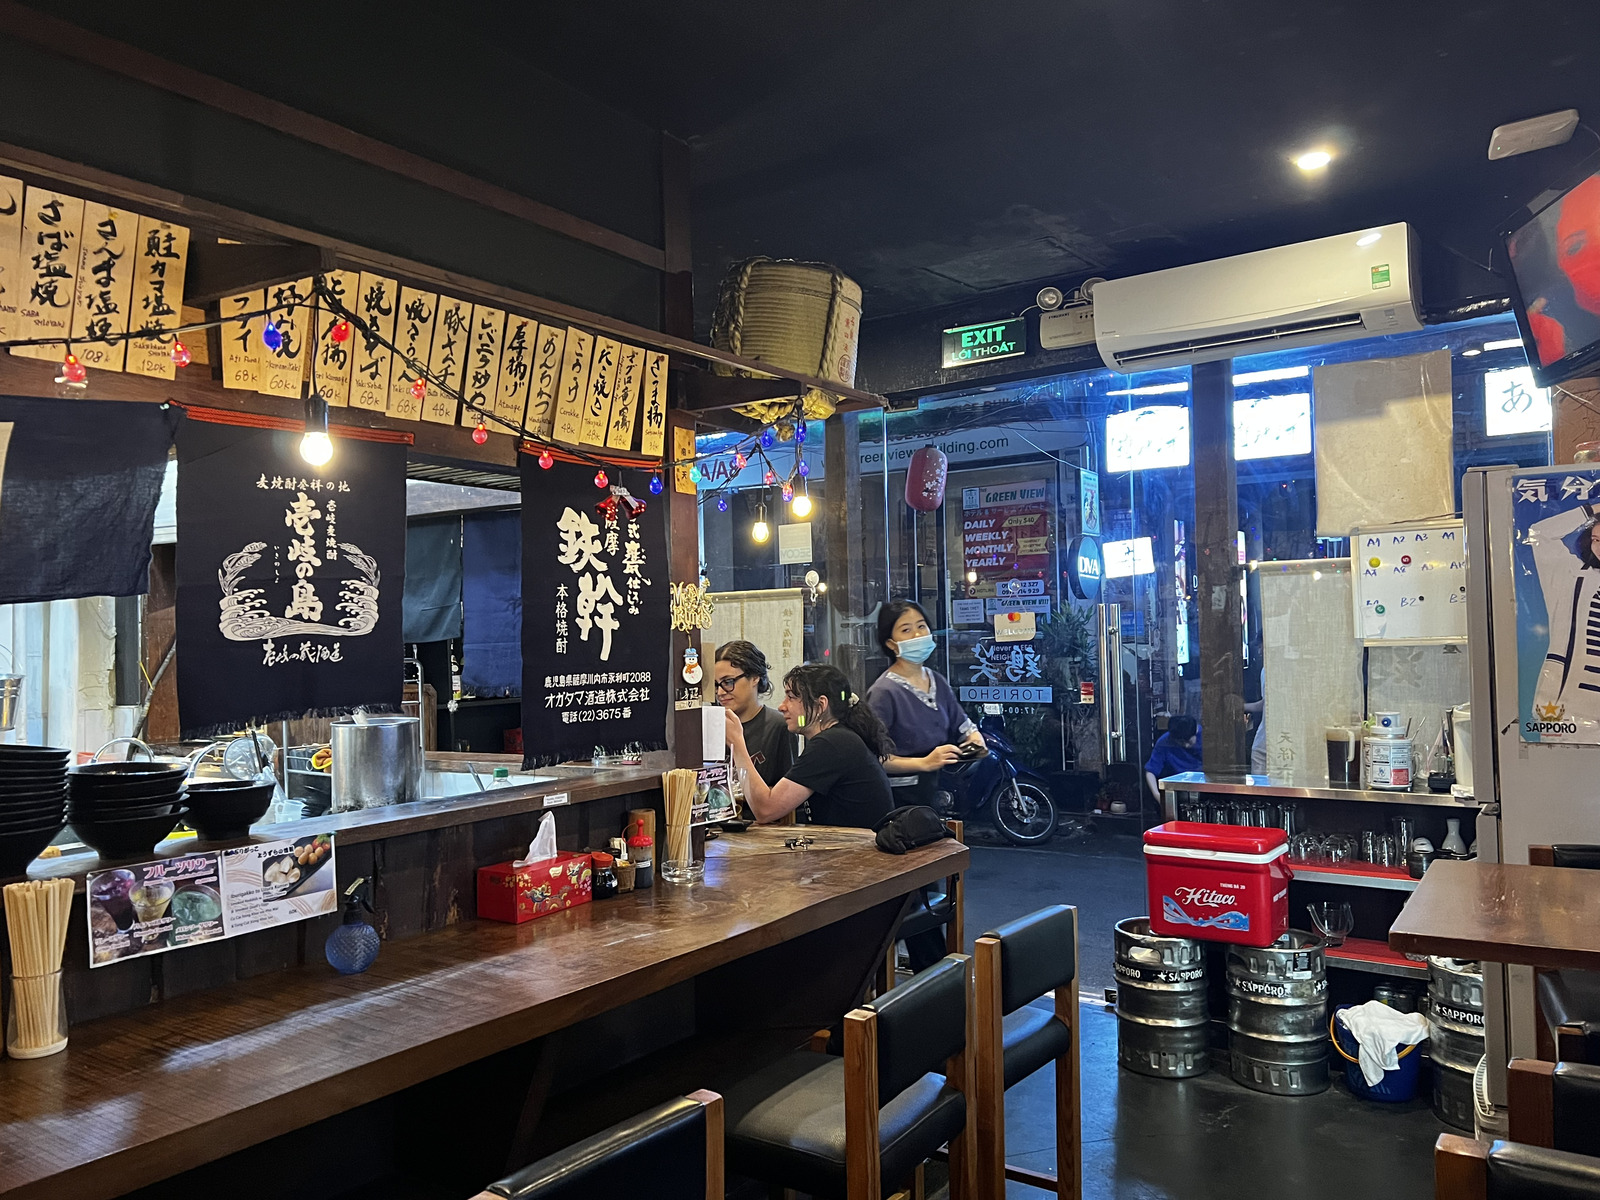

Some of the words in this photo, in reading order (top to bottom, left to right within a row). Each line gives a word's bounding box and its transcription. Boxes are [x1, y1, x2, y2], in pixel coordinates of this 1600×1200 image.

[29, 199, 75, 308] さば塩焼
[961, 325, 1005, 347] EXIT
[973, 341, 1016, 357] THOÁT
[505, 324, 529, 398] 厚揚げ
[590, 349, 613, 417] たこ焼き
[1501, 381, 1533, 414] あ
[985, 489, 1017, 504] GREEN
[1020, 487, 1045, 500] VIEW
[964, 518, 996, 530] DAILY
[965, 531, 1009, 542] WEEKLY
[285, 492, 323, 622] 壱岐の島
[965, 543, 1014, 555] MONTHLY
[965, 556, 1007, 568] YEARLY
[555, 583, 569, 655] 本格焼酎
[996, 627, 1035, 636] WELCOME
[544, 687, 651, 709] オガタマ酒造株式会社
[561, 706, 632, 724] 電話(22)3675番
[1525, 721, 1578, 735] SAPPORO
[143, 858, 217, 879] フルーツサワー
[1174, 886, 1236, 908] Hitaco
[1168, 968, 1203, 982] SAPPORO
[1242, 980, 1285, 996] SAPPORO
